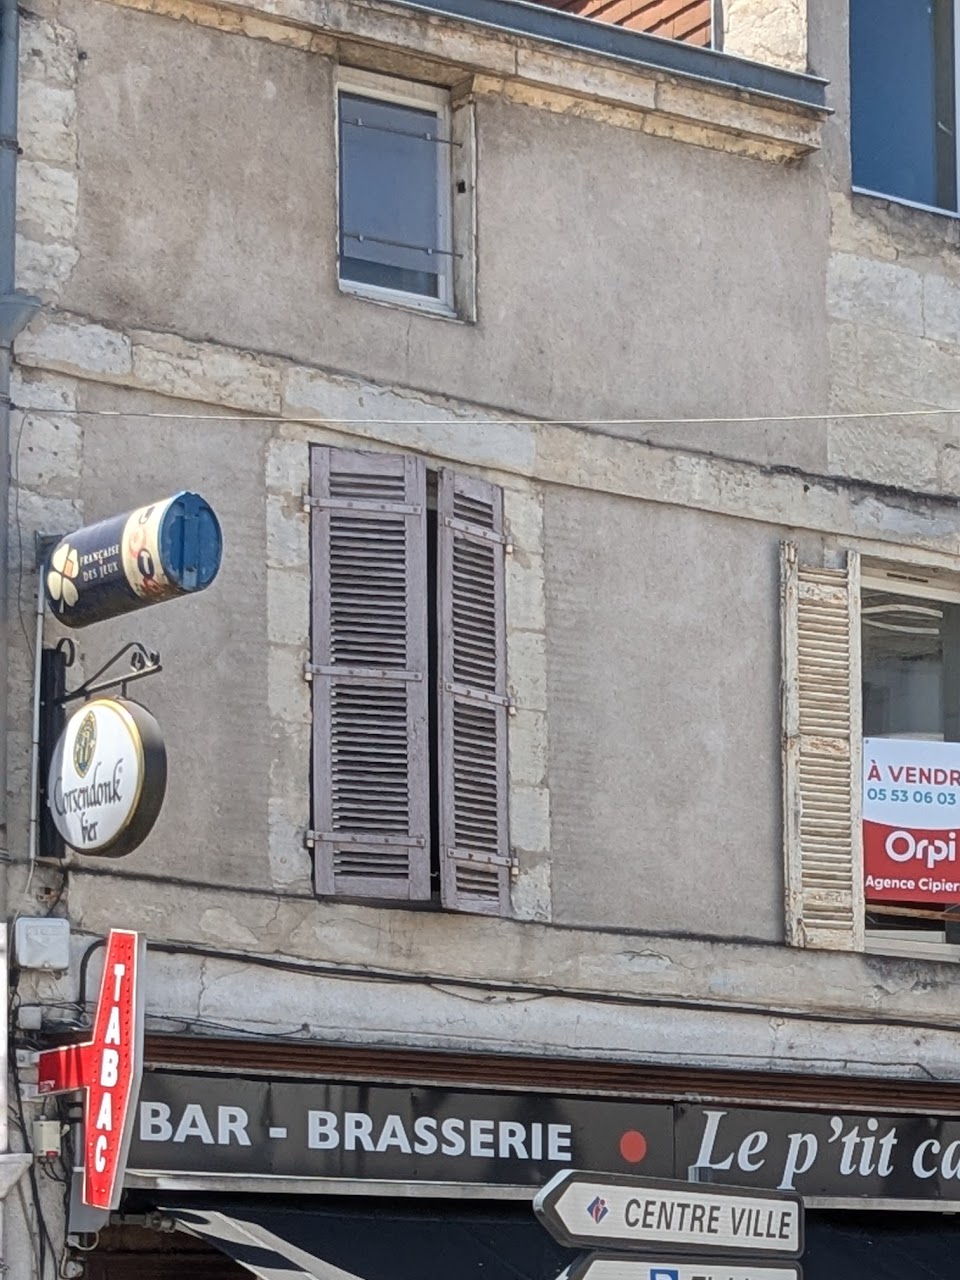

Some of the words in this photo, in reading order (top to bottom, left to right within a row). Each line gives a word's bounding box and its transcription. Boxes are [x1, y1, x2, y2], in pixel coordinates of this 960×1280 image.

[79, 544, 120, 565] FRANÇAISE
[83, 568, 98, 582] DES
[99, 562, 118, 579] JEUX
[54, 758, 123, 816] Corsendonk
[867, 759, 882, 782] À
[867, 788, 887, 801] 05
[890, 789, 909, 802] 53
[913, 791, 933, 804] 06
[937, 792, 956, 805] 03
[81, 812, 98, 844] bier
[885, 830, 957, 868] Orpi
[865, 875, 915, 890] Agence
[95, 963, 126, 1173] TABAC
[139, 1101, 251, 1146] BAR
[269, 1127, 287, 1138] -
[307, 1110, 572, 1162] BRASSERIE
[698, 1110, 768, 1172] Le
[777, 1115, 898, 1190] p'tit
[624, 1198, 721, 1234] CENTRE
[731, 1207, 792, 1239] VILLE
